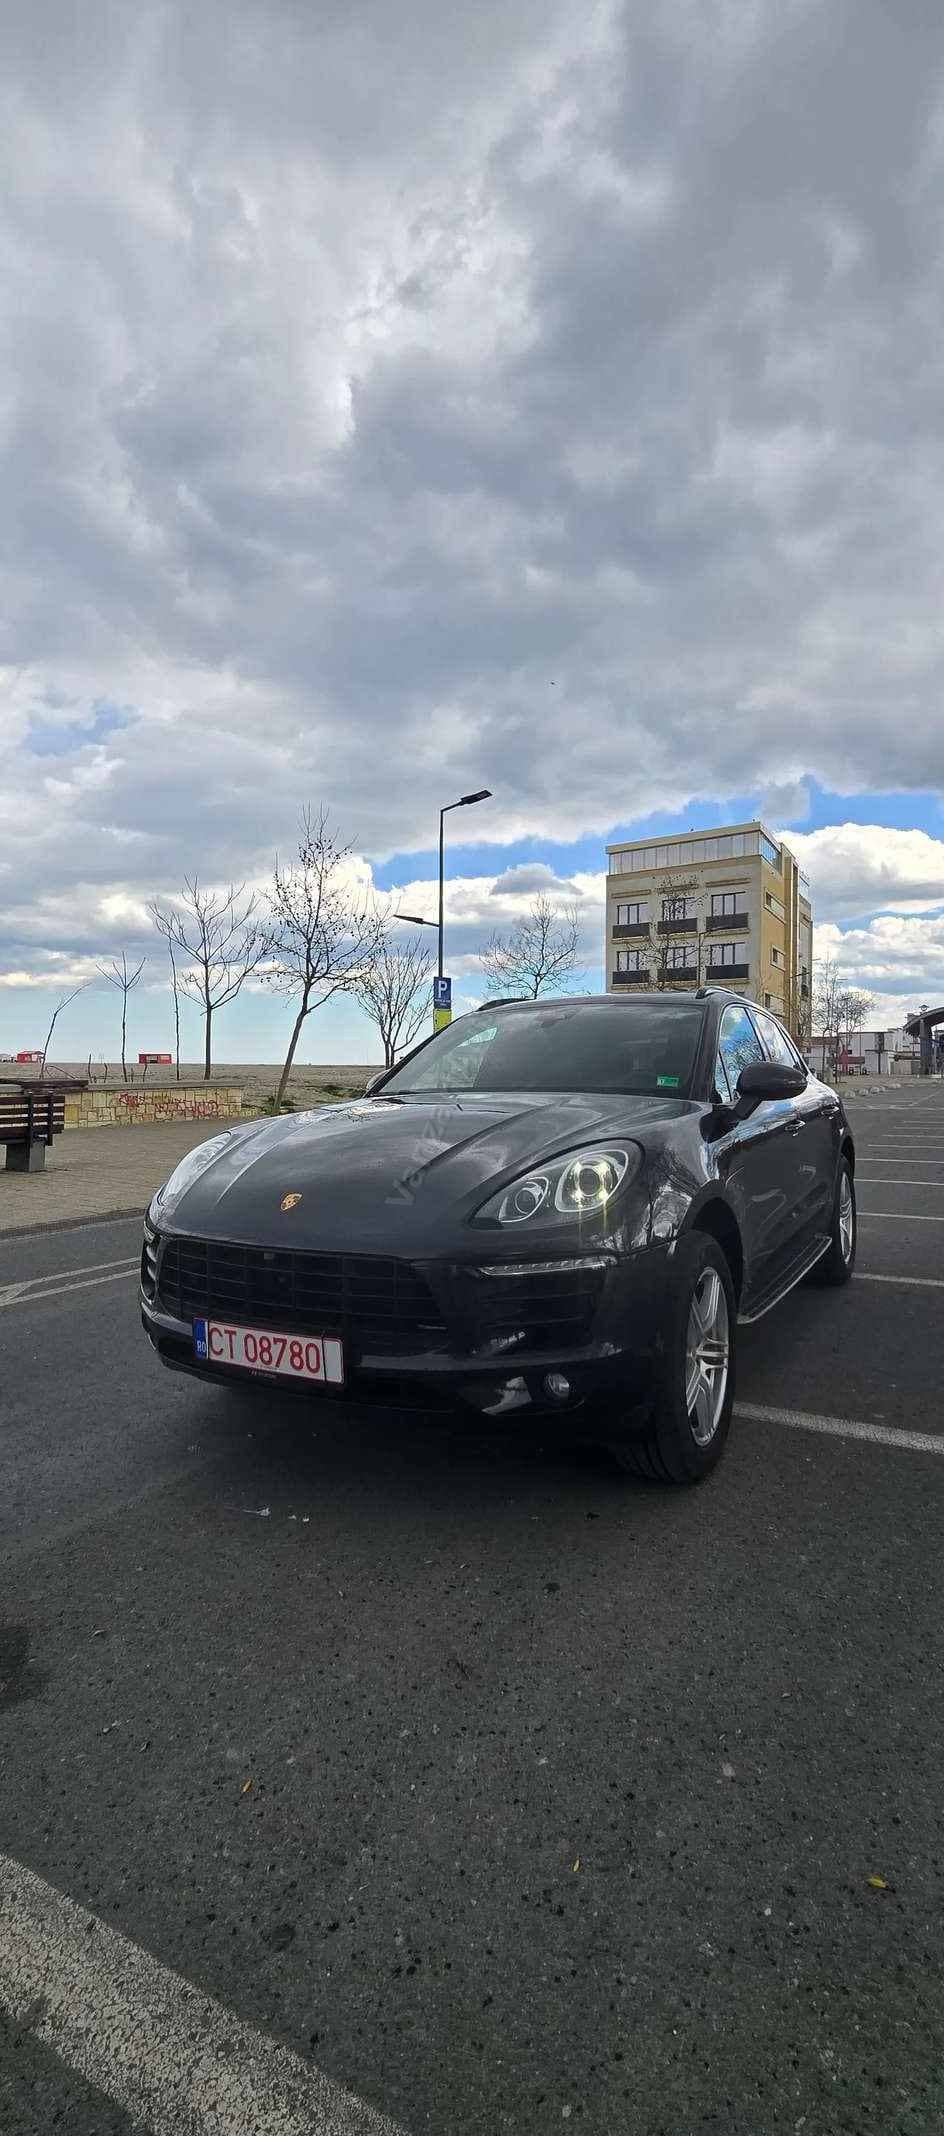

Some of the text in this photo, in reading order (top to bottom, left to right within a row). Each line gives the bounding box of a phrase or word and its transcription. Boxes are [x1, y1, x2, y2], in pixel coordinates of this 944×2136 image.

[438, 980, 448, 998] P
[196, 1340, 207, 1353] RO
[208, 1327, 321, 1374] CT 08780
